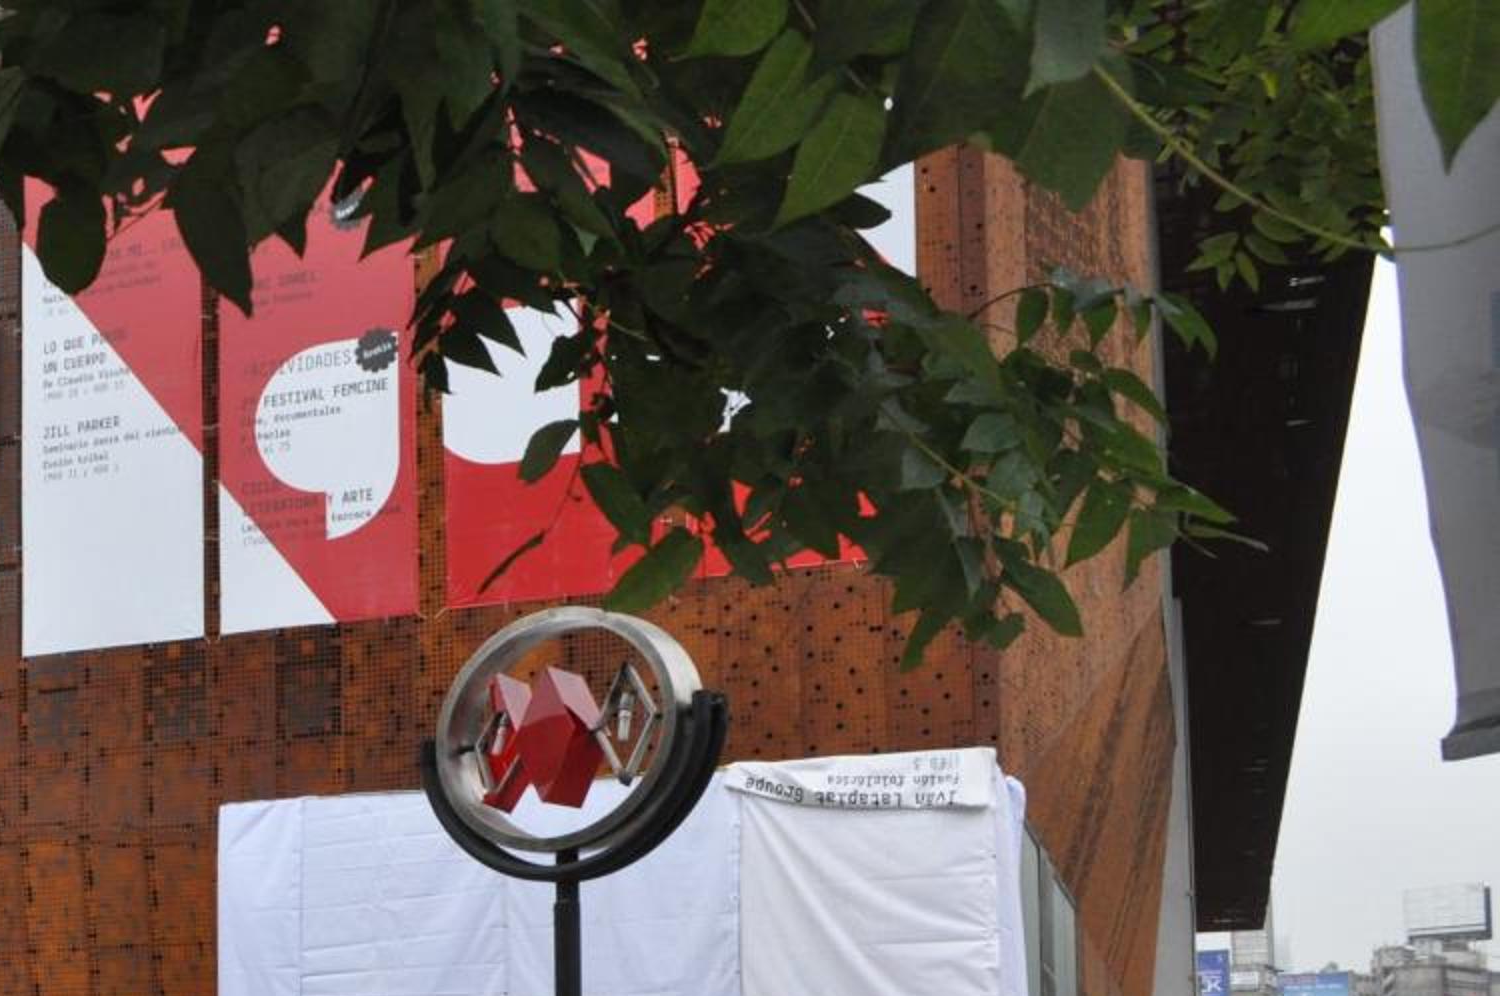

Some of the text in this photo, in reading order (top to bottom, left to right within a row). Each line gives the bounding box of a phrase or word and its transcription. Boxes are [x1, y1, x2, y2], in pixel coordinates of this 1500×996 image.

[63, 352, 107, 371] CUERPO
[263, 386, 324, 408] FESTIVAL
[333, 377, 389, 398] FEMCINE
[342, 487, 373, 504] ARTE
[744, 775, 805, 803] Groupe
